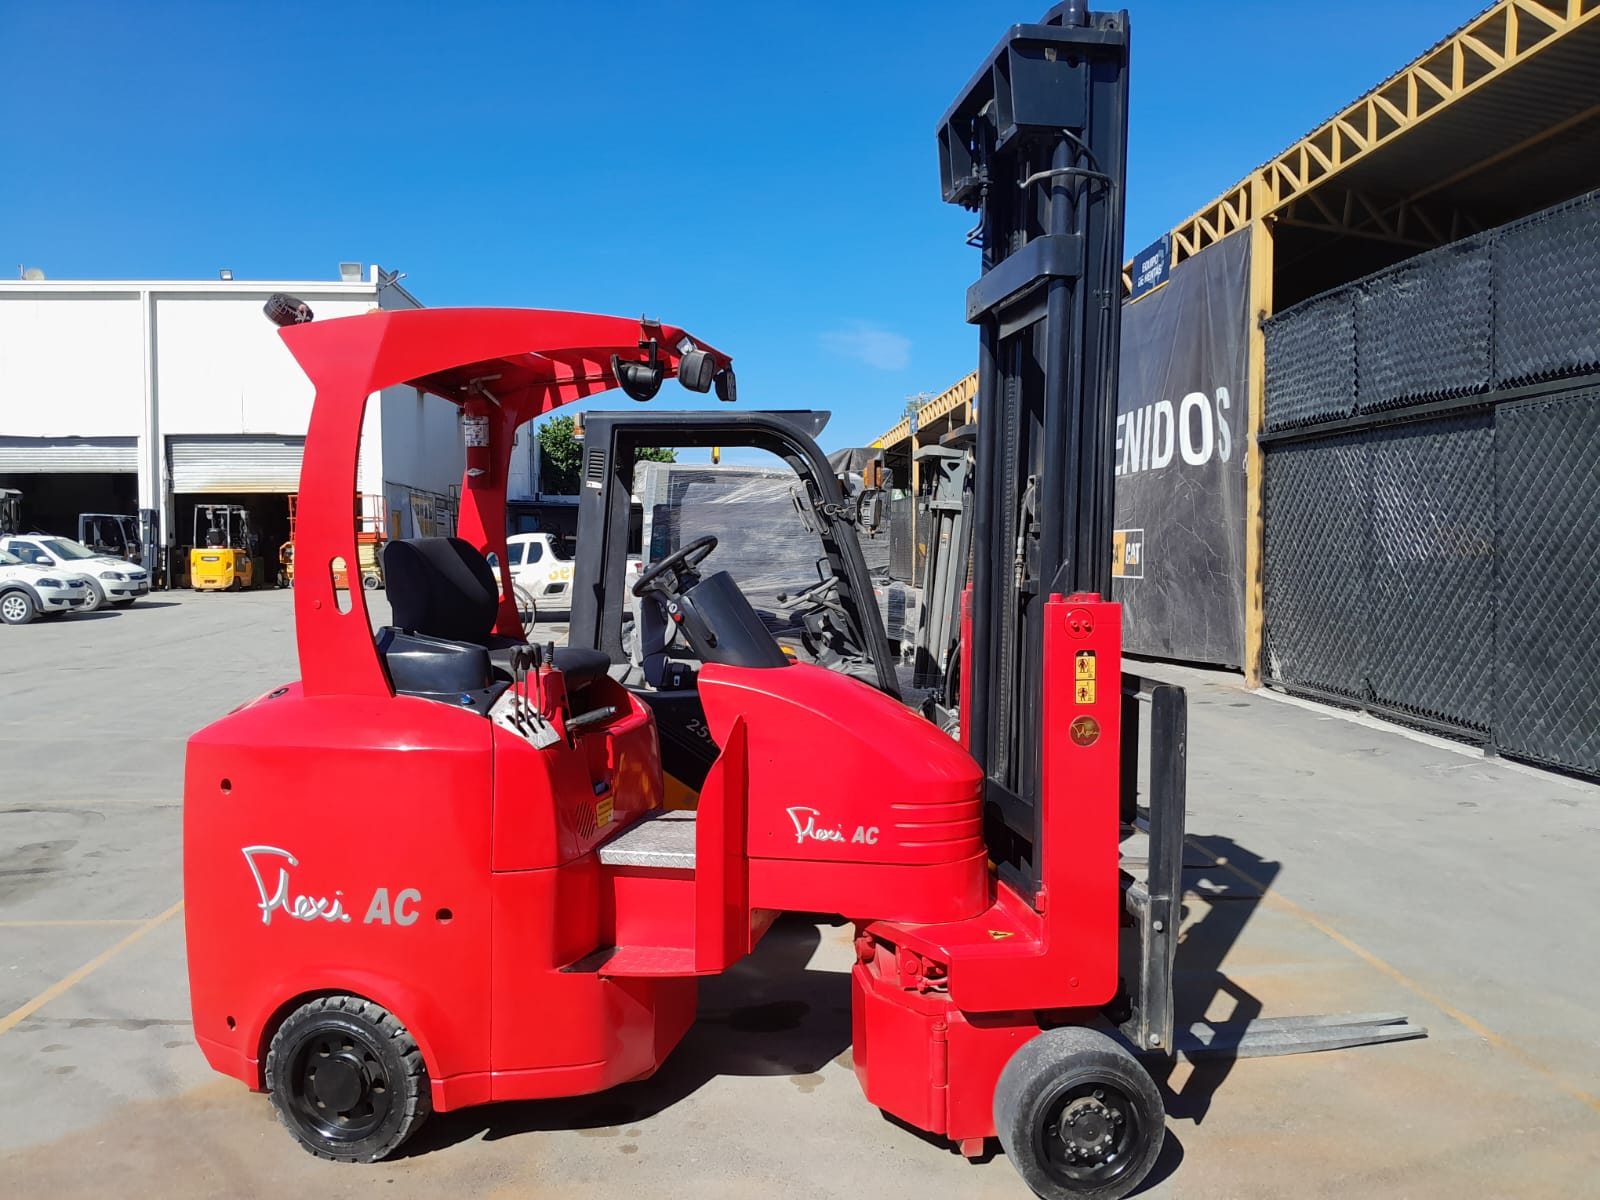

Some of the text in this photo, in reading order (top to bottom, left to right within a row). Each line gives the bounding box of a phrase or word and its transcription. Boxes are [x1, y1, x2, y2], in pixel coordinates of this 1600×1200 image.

[1141, 253, 1160, 274] EQUIPO
[1125, 542, 1142, 565] CAT
[785, 806, 880, 845] Flexi AC
[241, 845, 422, 926] Flexi AC
